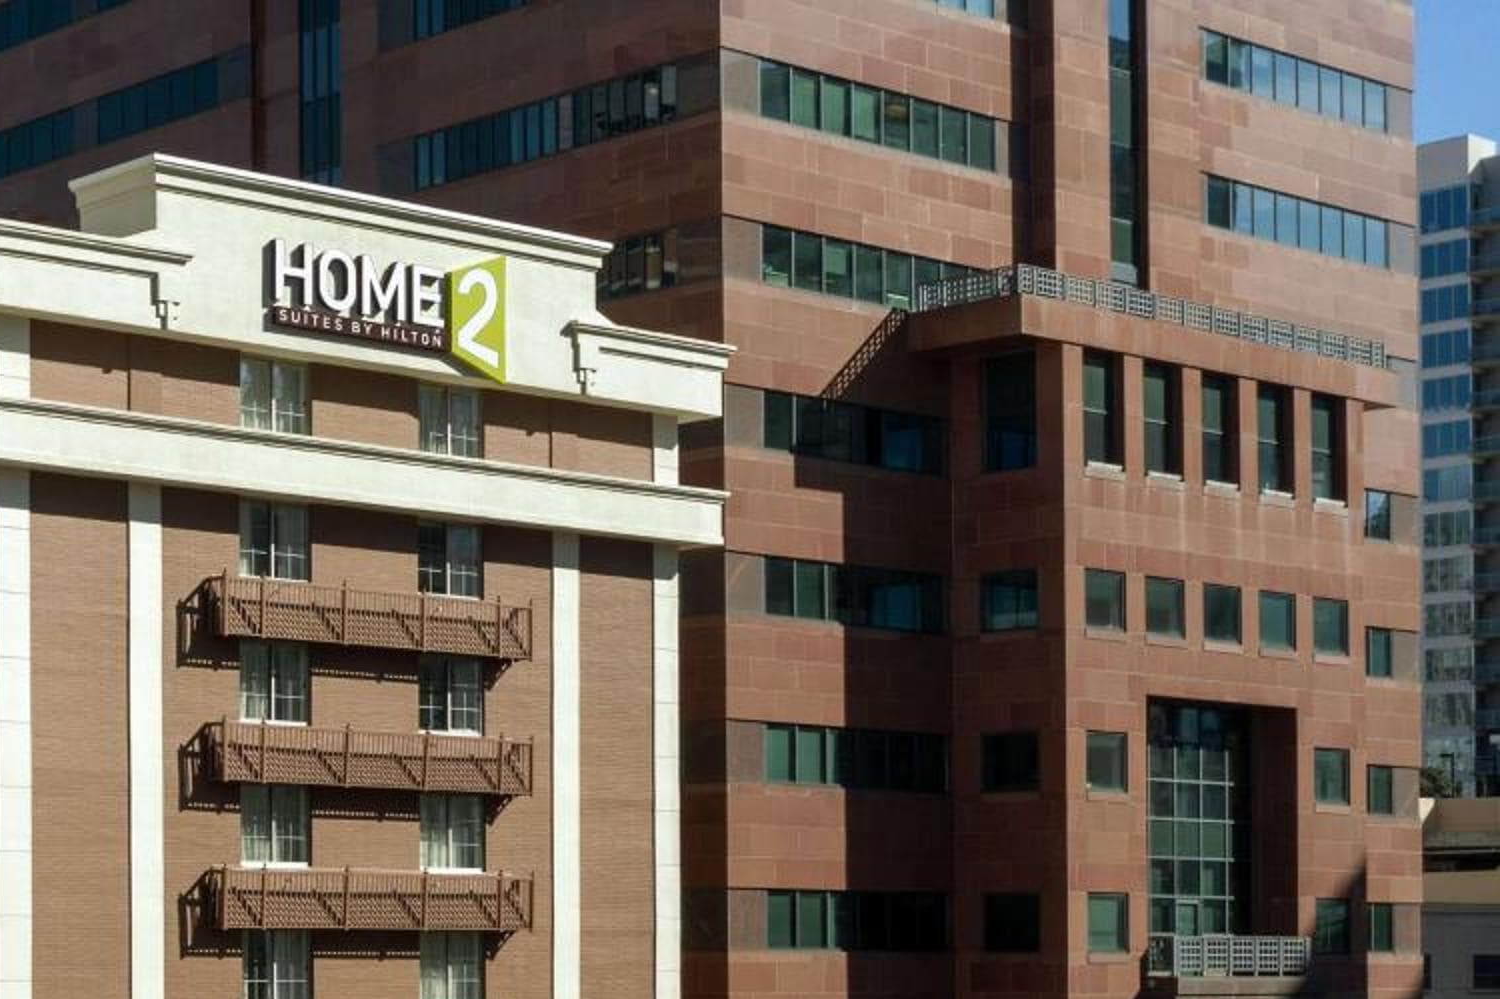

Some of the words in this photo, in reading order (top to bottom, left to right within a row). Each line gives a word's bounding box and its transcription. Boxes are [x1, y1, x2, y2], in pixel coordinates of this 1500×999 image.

[268, 238, 445, 328] HOME
[457, 268, 500, 369] 2
[278, 309, 343, 331] SUITES
[351, 320, 372, 335] BY
[381, 326, 442, 348] HILTON
